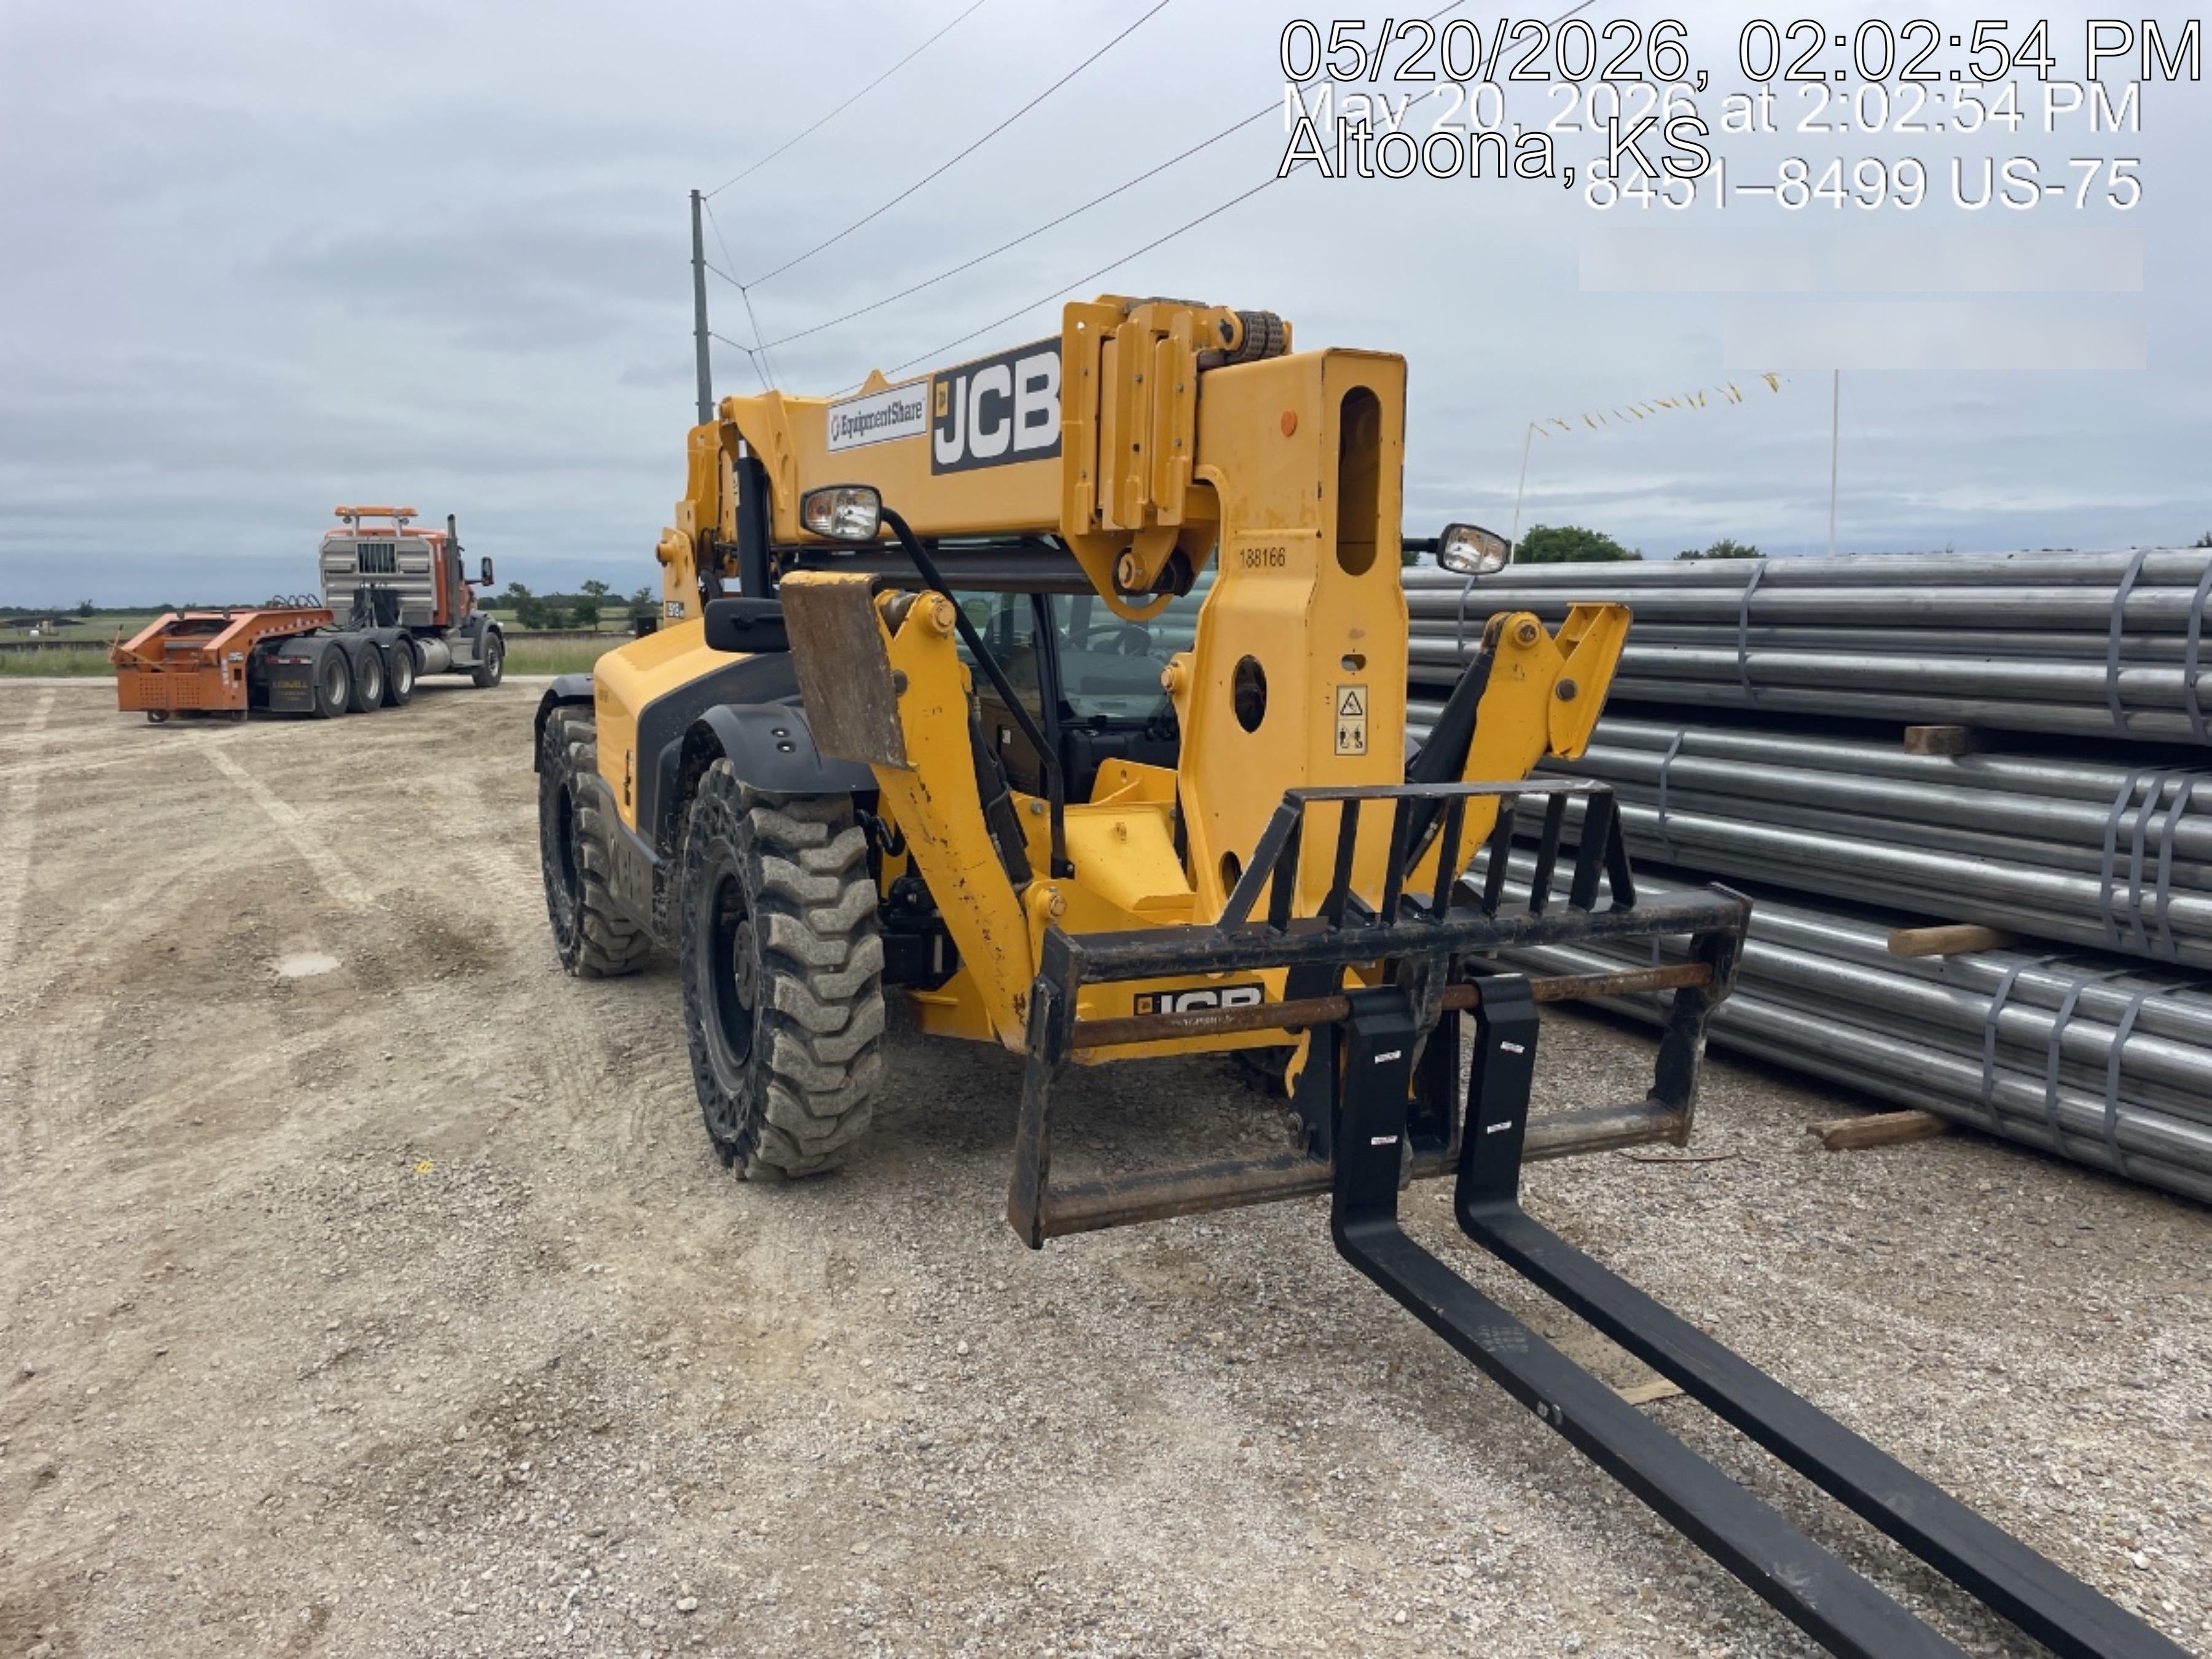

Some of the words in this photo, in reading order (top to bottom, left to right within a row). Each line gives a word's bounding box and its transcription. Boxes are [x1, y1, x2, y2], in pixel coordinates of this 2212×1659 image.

[841, 401, 922, 439] EquipmentShare
[935, 351, 1061, 465] JCB
[1239, 546, 1285, 568] 188166
